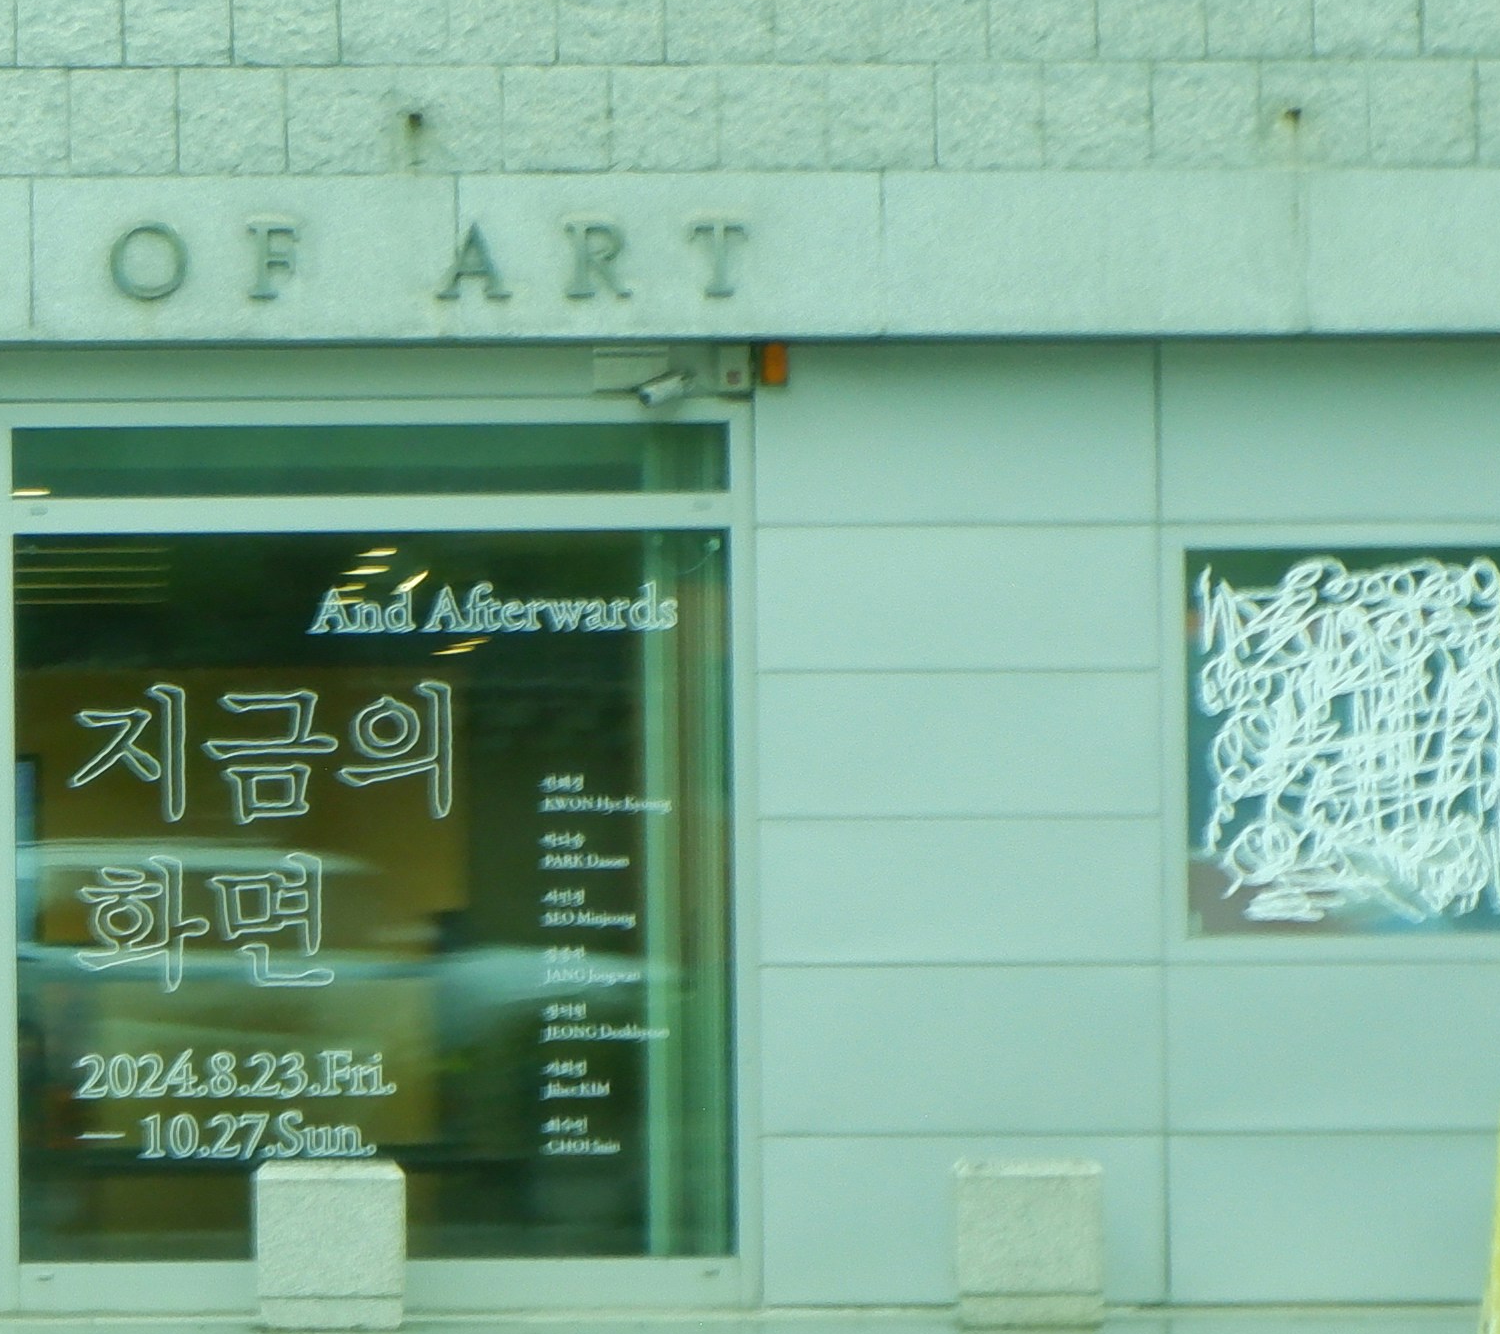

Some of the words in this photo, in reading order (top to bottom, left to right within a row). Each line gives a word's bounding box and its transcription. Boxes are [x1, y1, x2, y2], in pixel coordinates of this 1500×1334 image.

[109, 220, 299, 301] OF
[435, 220, 748, 299] ART
[306, 585, 415, 634] And
[419, 579, 678, 634] Afterwards
[67, 679, 452, 825] 지금의
[541, 854, 582, 869] PARK
[74, 852, 335, 993] 화면
[73, 1048, 397, 1099] 2024.8.23.Fri.
[579, 1082, 610, 1097] KIM
[137, 1109, 376, 1159] 10.27.Sun.
